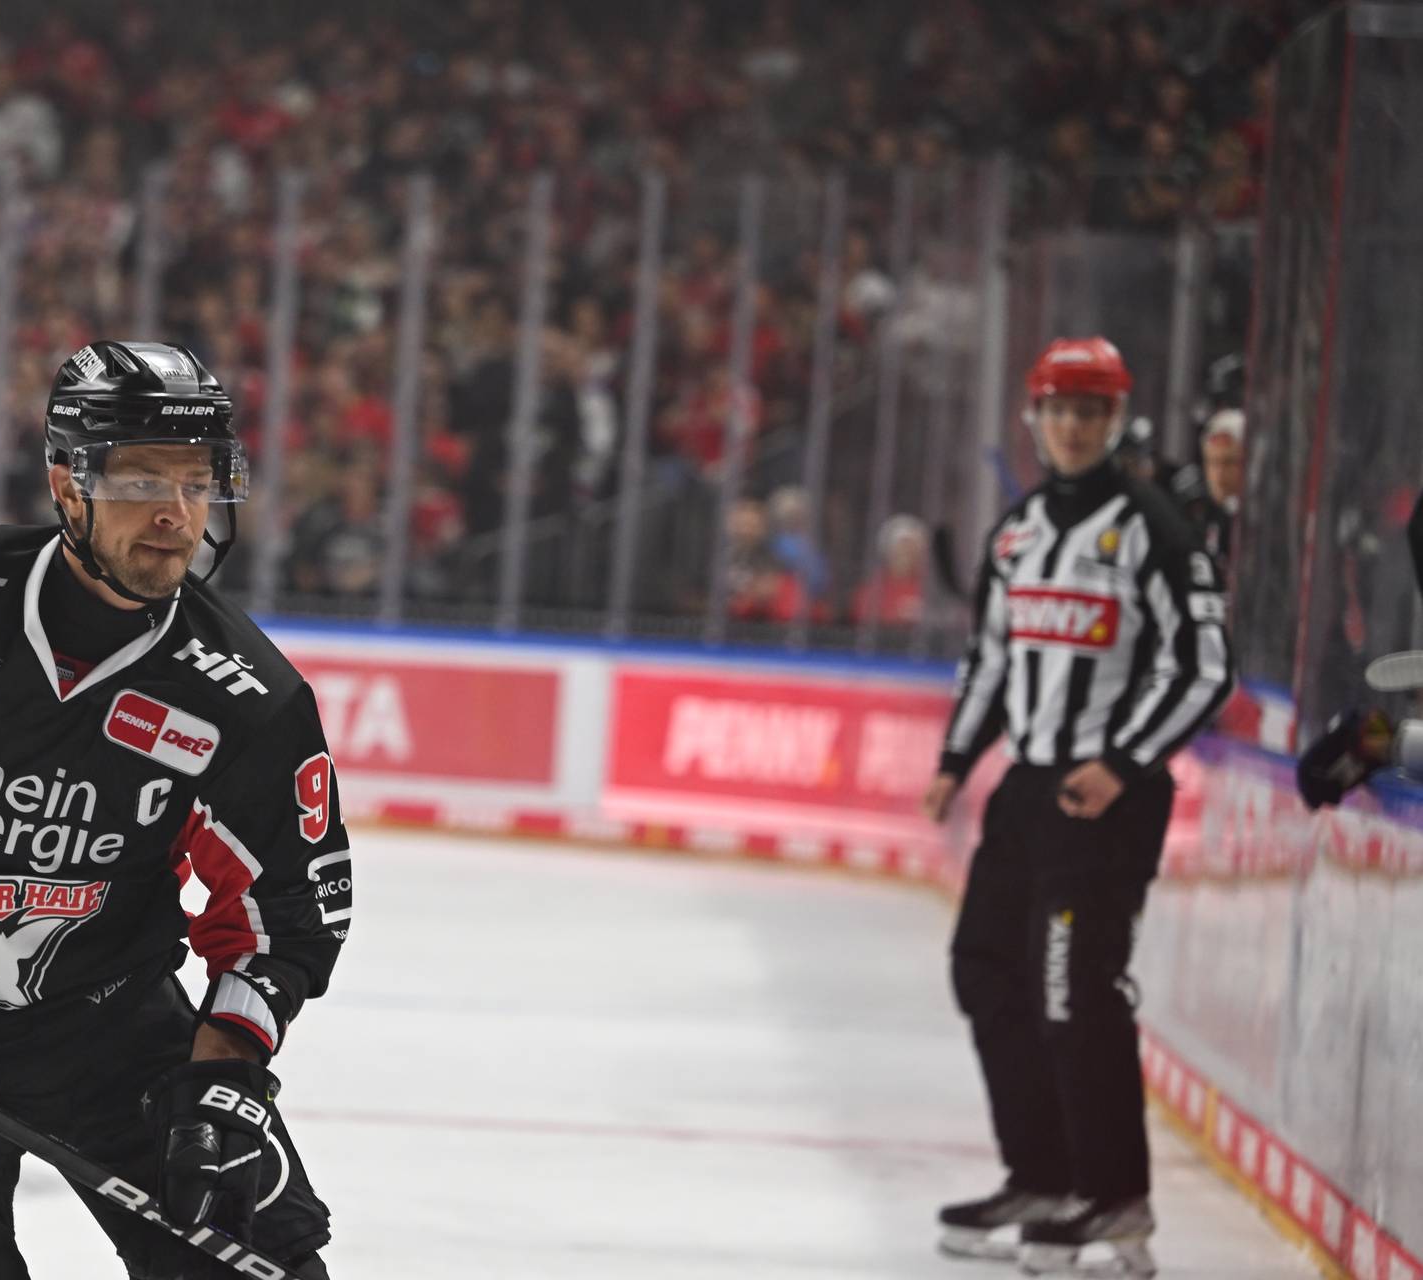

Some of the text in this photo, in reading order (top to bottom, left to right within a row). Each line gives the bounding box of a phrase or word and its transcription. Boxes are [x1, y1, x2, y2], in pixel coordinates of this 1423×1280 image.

[53, 404, 81, 417] BAUER
[161, 405, 215, 416] BAUER
[172, 638, 269, 696] HIT
[115, 711, 157, 735] PENNY.
[136, 778, 173, 827] C
[294, 751, 344, 845] 9
[24, 881, 106, 908] HAIE
